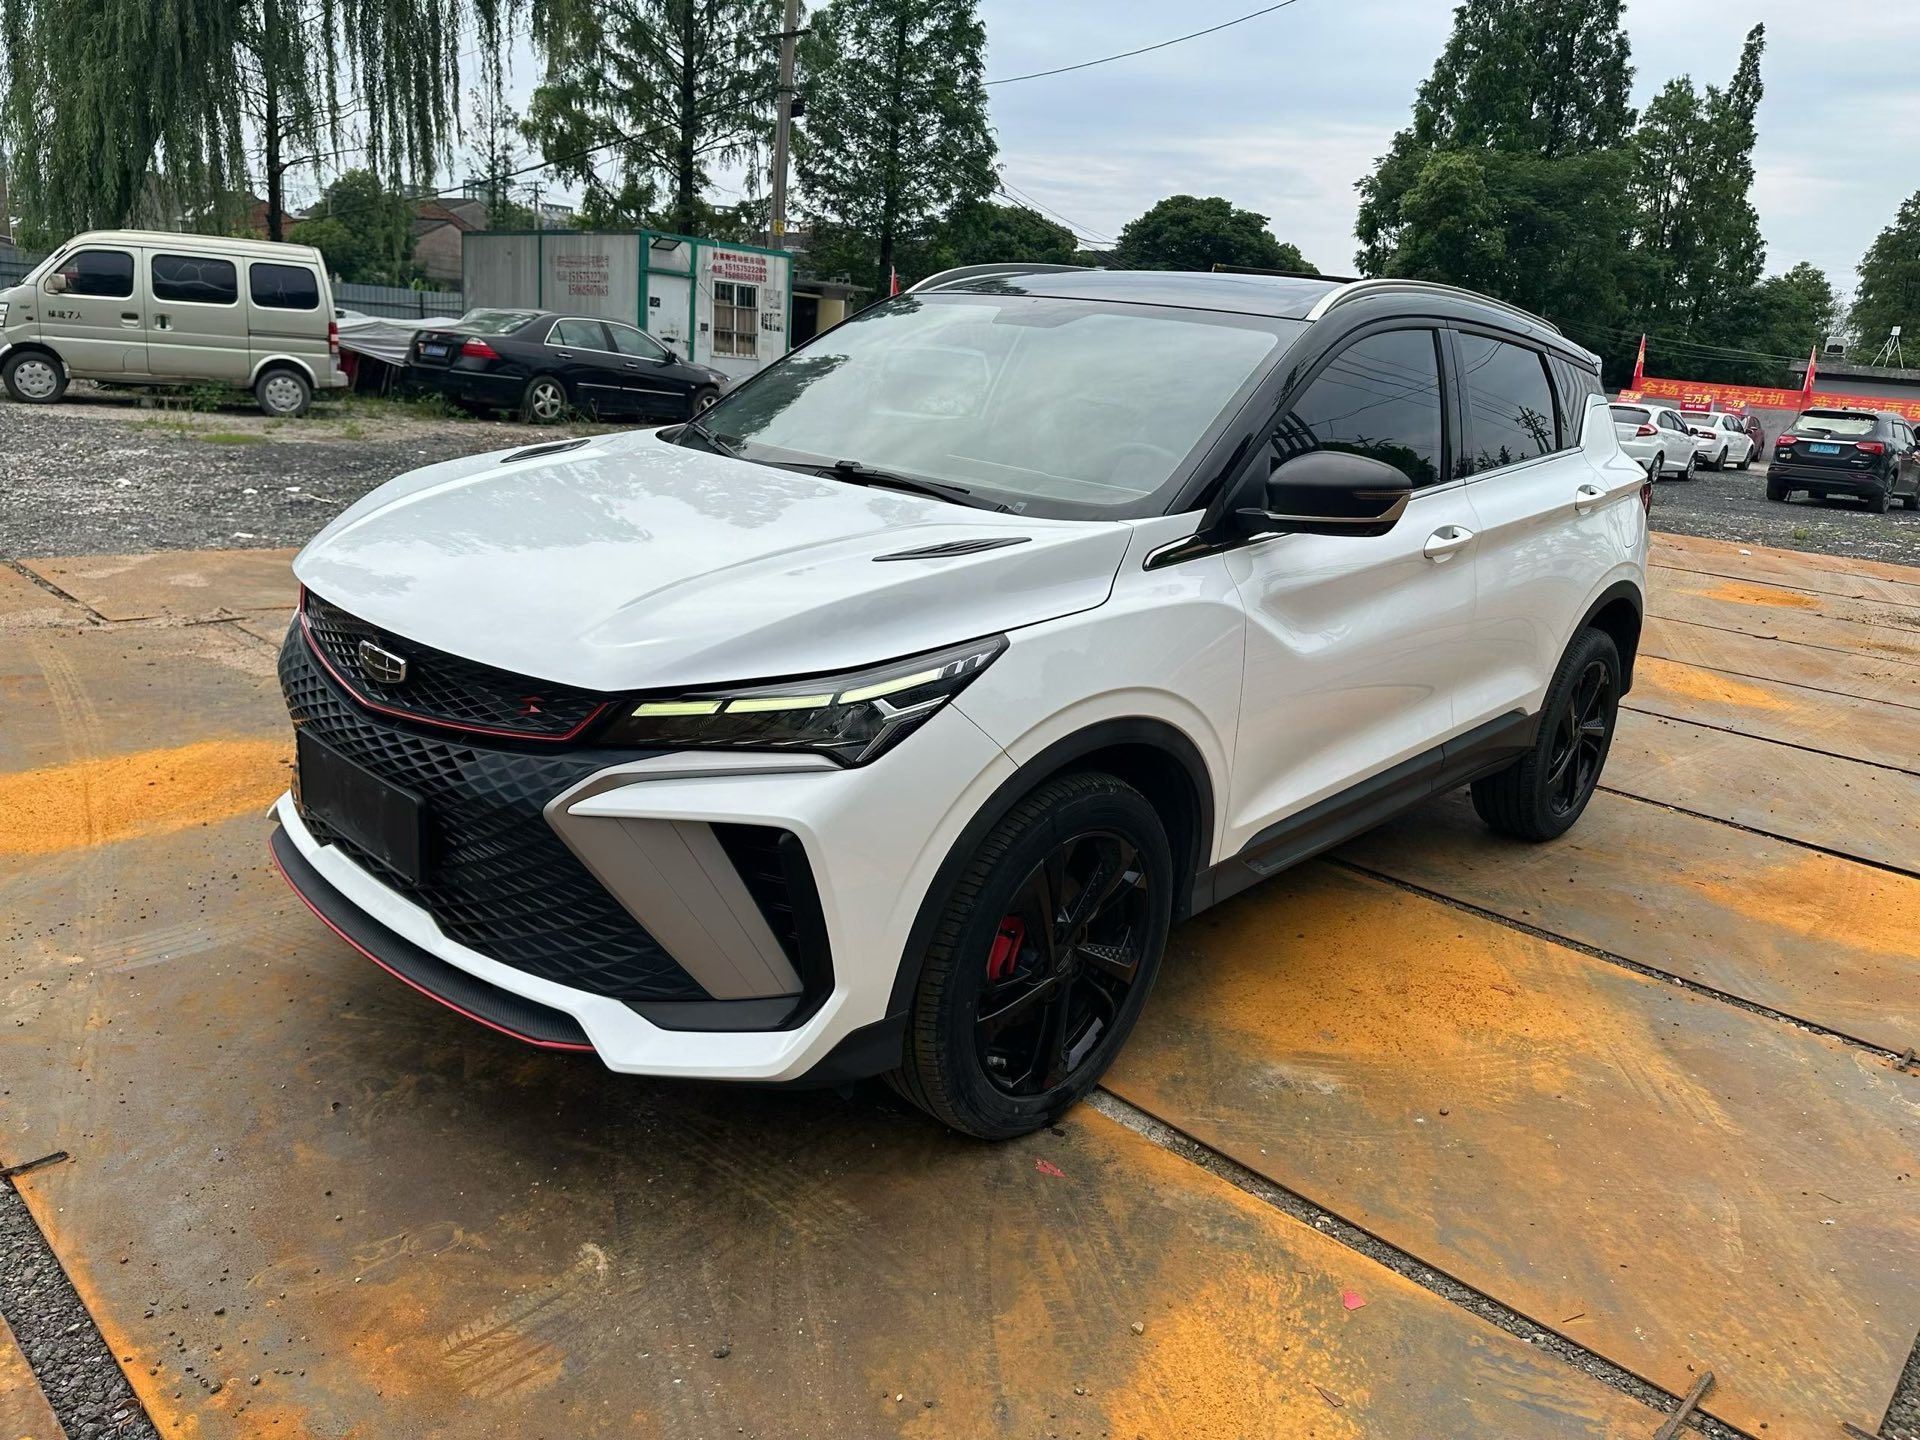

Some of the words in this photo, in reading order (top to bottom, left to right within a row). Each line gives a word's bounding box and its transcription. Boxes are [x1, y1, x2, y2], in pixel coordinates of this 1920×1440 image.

[1682, 393, 1712, 404] 三万多
[1725, 399, 1746, 408] 一万多
